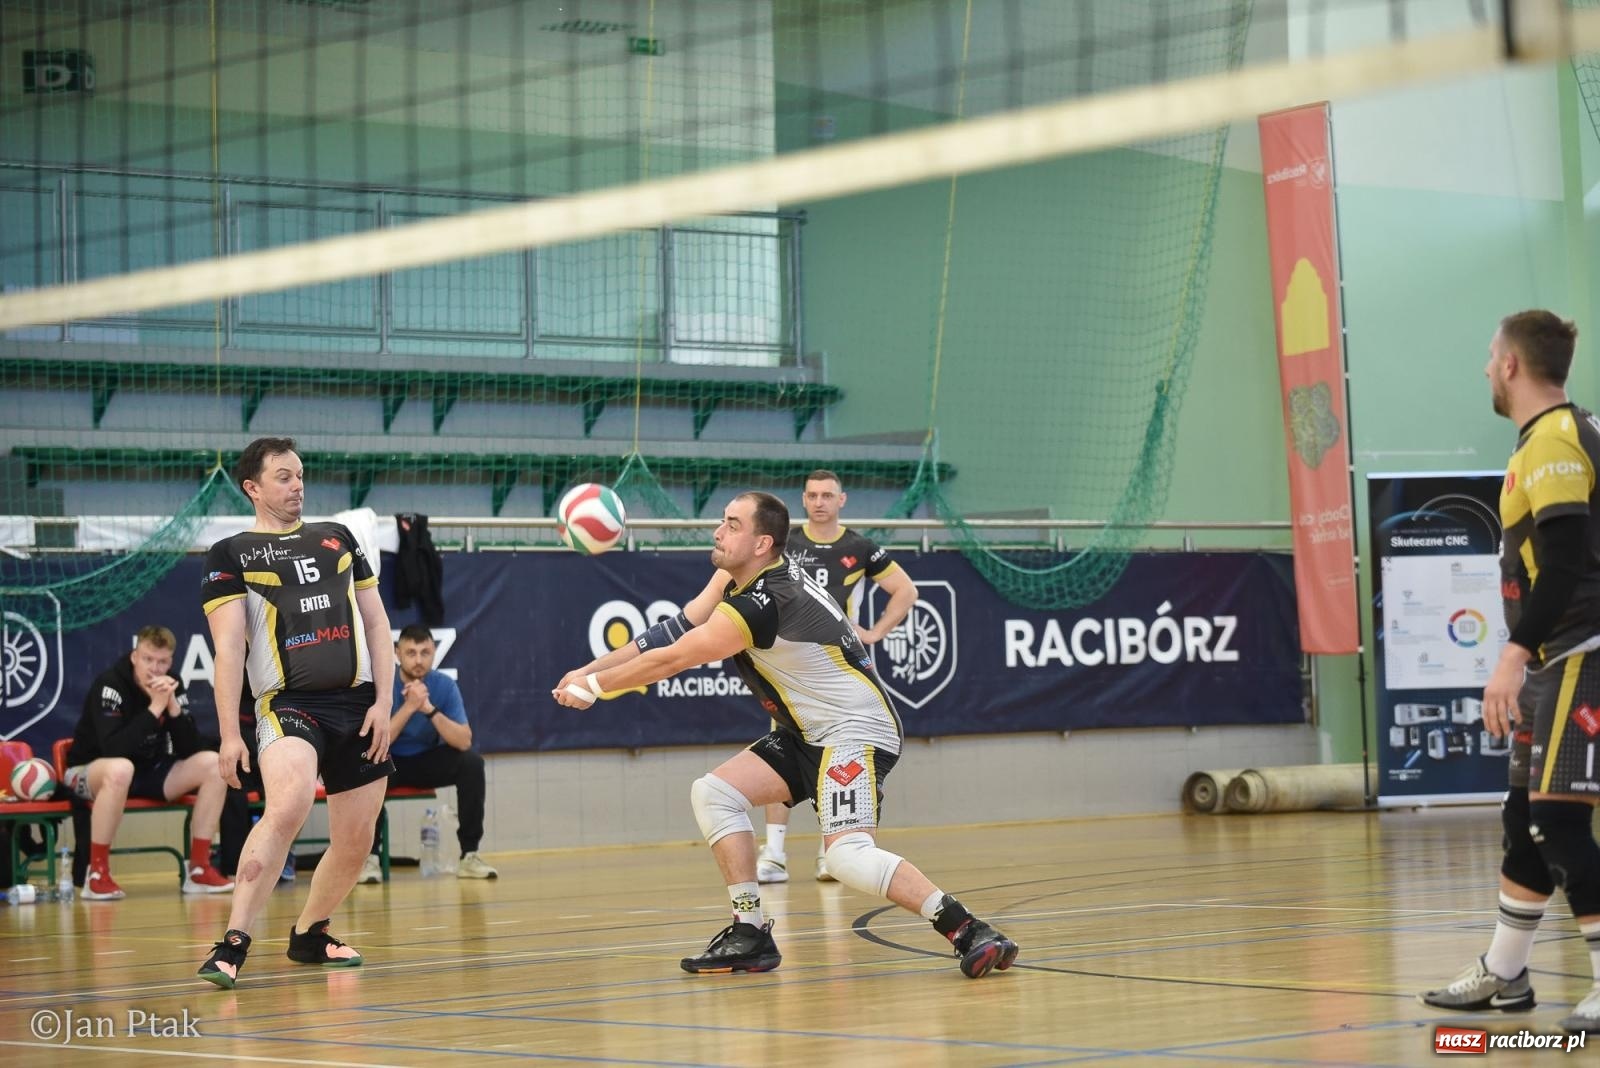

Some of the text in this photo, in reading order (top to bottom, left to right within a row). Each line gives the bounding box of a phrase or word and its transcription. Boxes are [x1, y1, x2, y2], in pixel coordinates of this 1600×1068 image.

[1390, 535, 1469, 548] Skuteczne CNC
[293, 557, 320, 585] 15
[816, 568, 828, 587] 8
[300, 594, 331, 613] ENTER
[1005, 600, 1239, 668] RACIBÓRZ
[832, 789, 856, 817] 14
